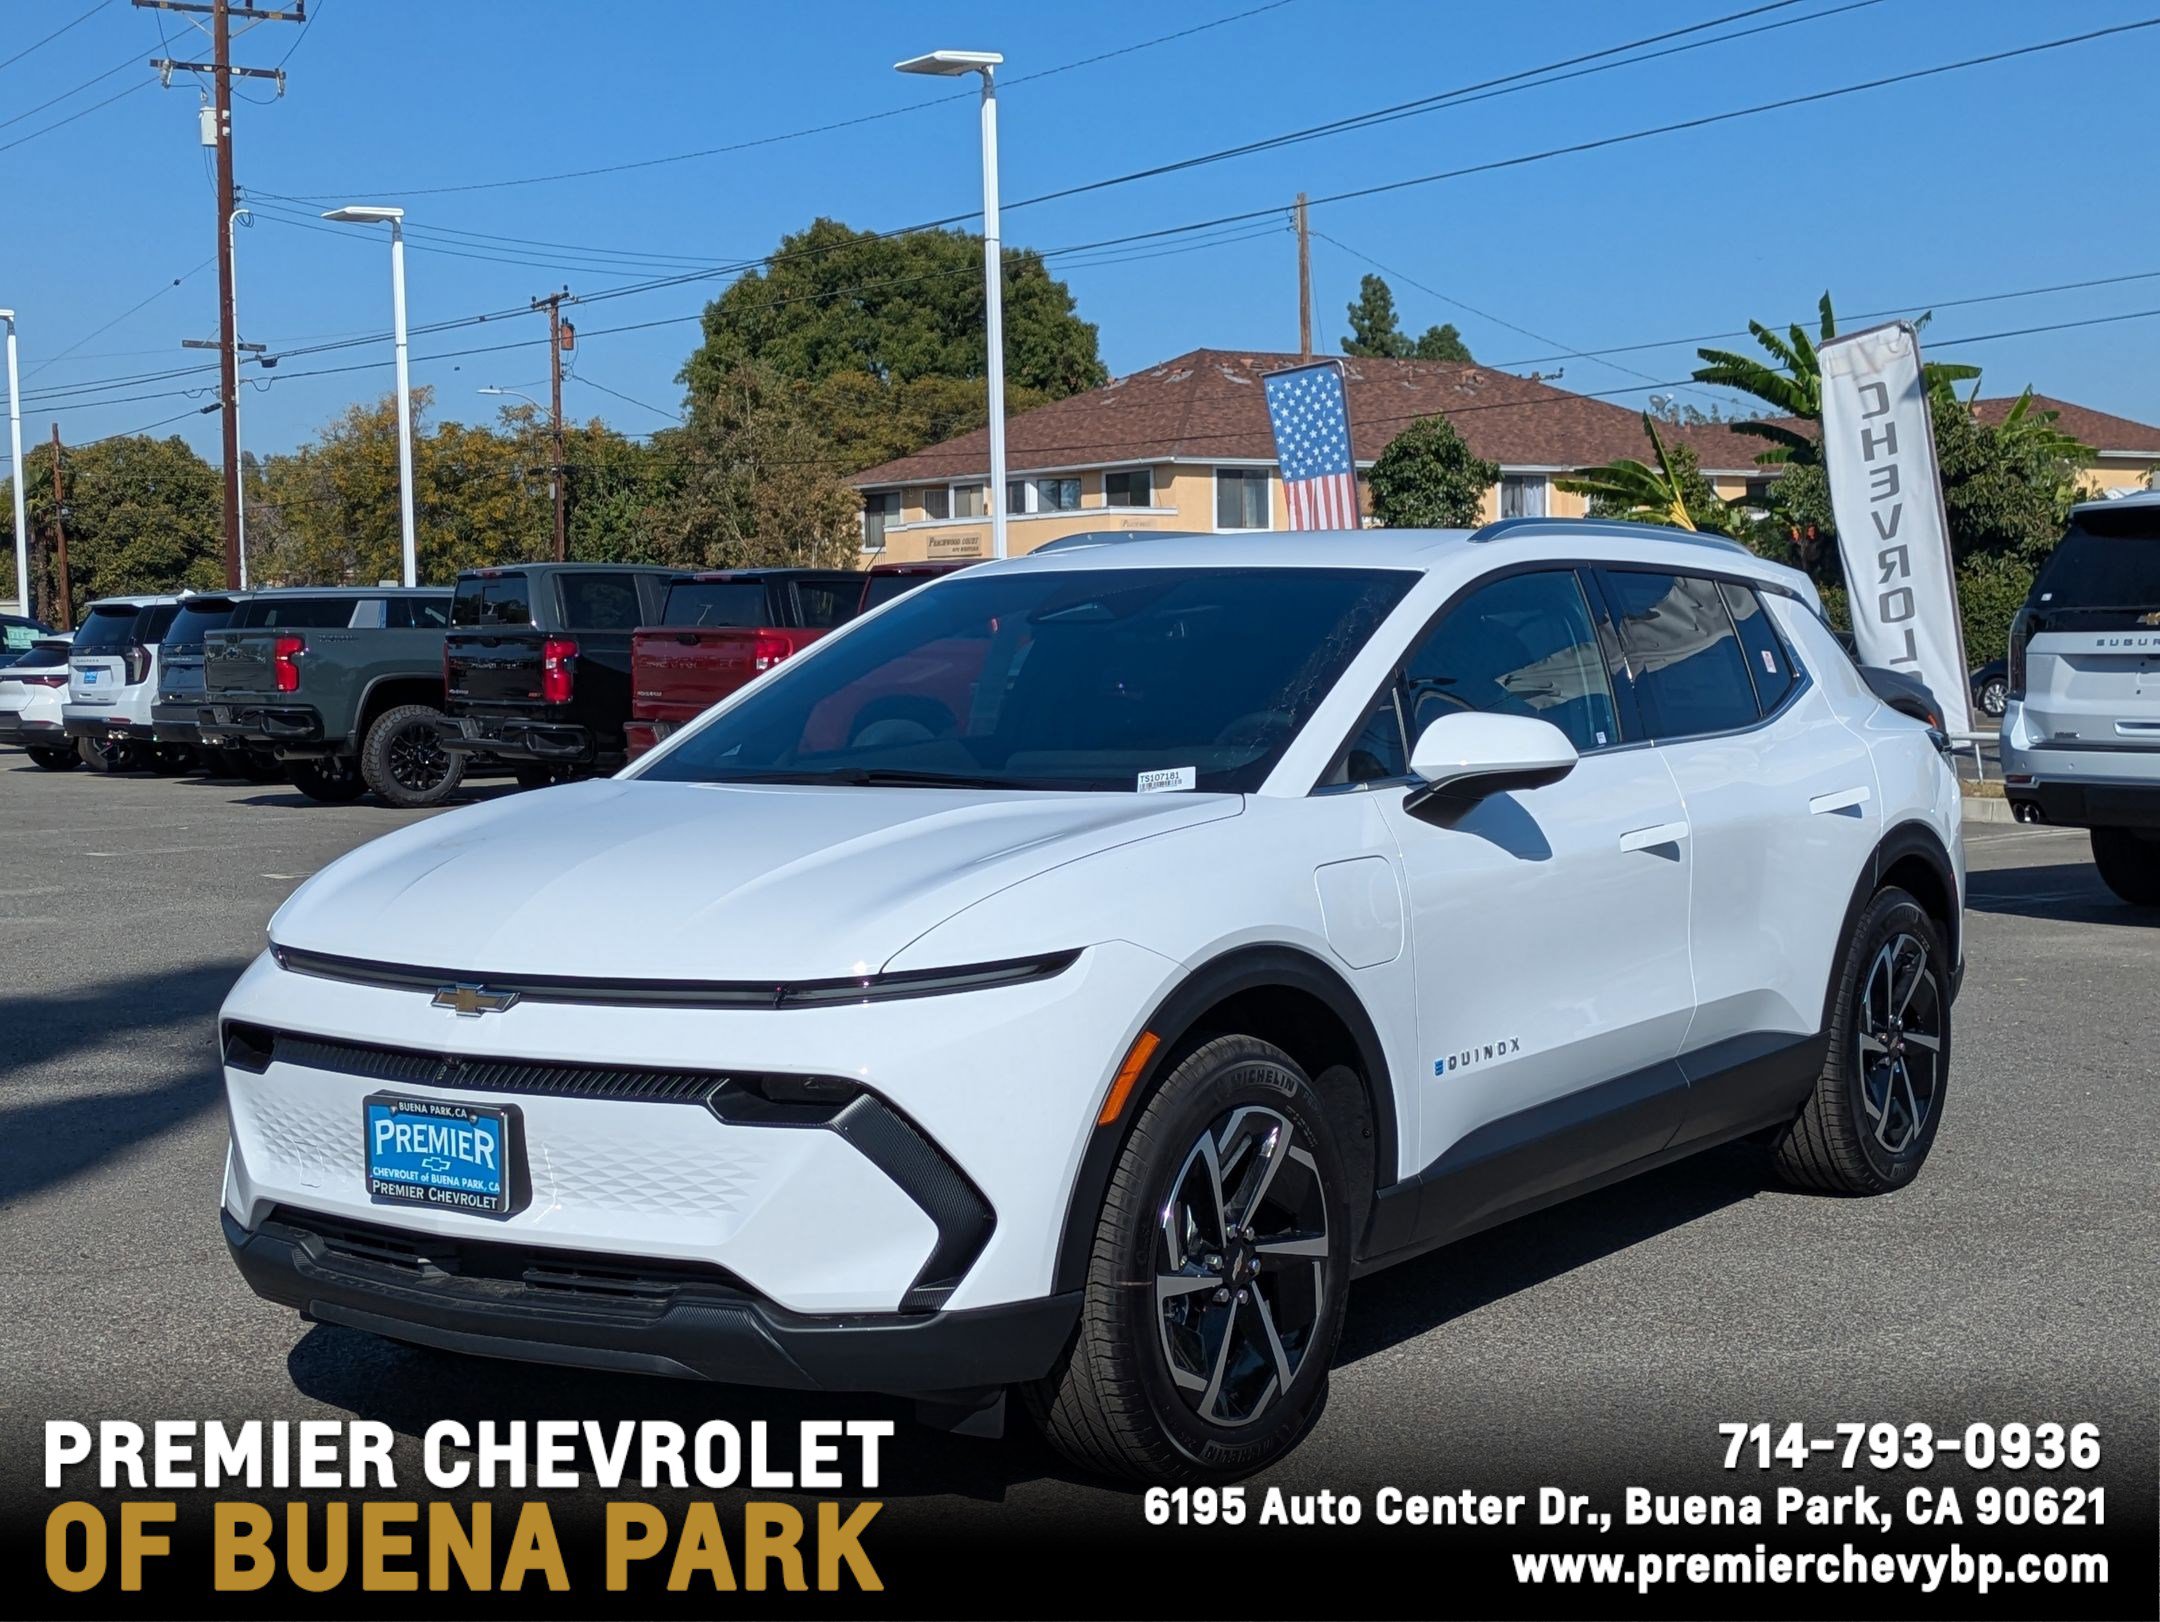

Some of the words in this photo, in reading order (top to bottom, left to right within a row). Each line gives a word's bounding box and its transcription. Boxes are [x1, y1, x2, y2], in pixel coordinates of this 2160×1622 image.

[1139, 771, 1180, 784] TS107181
[1434, 1037, 1520, 1076] EQUINOX
[398, 1101, 429, 1114] BUENA
[374, 1119, 496, 1170] PREMIER
[372, 1166, 419, 1181] CHEVROLET
[420, 1174, 430, 1183] of
[431, 1174, 461, 1187] BUENA
[461, 1178, 488, 1192] PARK,
[488, 1182, 500, 1193] CA
[372, 1180, 424, 1199] PREMIER
[428, 1187, 498, 1210] CHEVROLET
